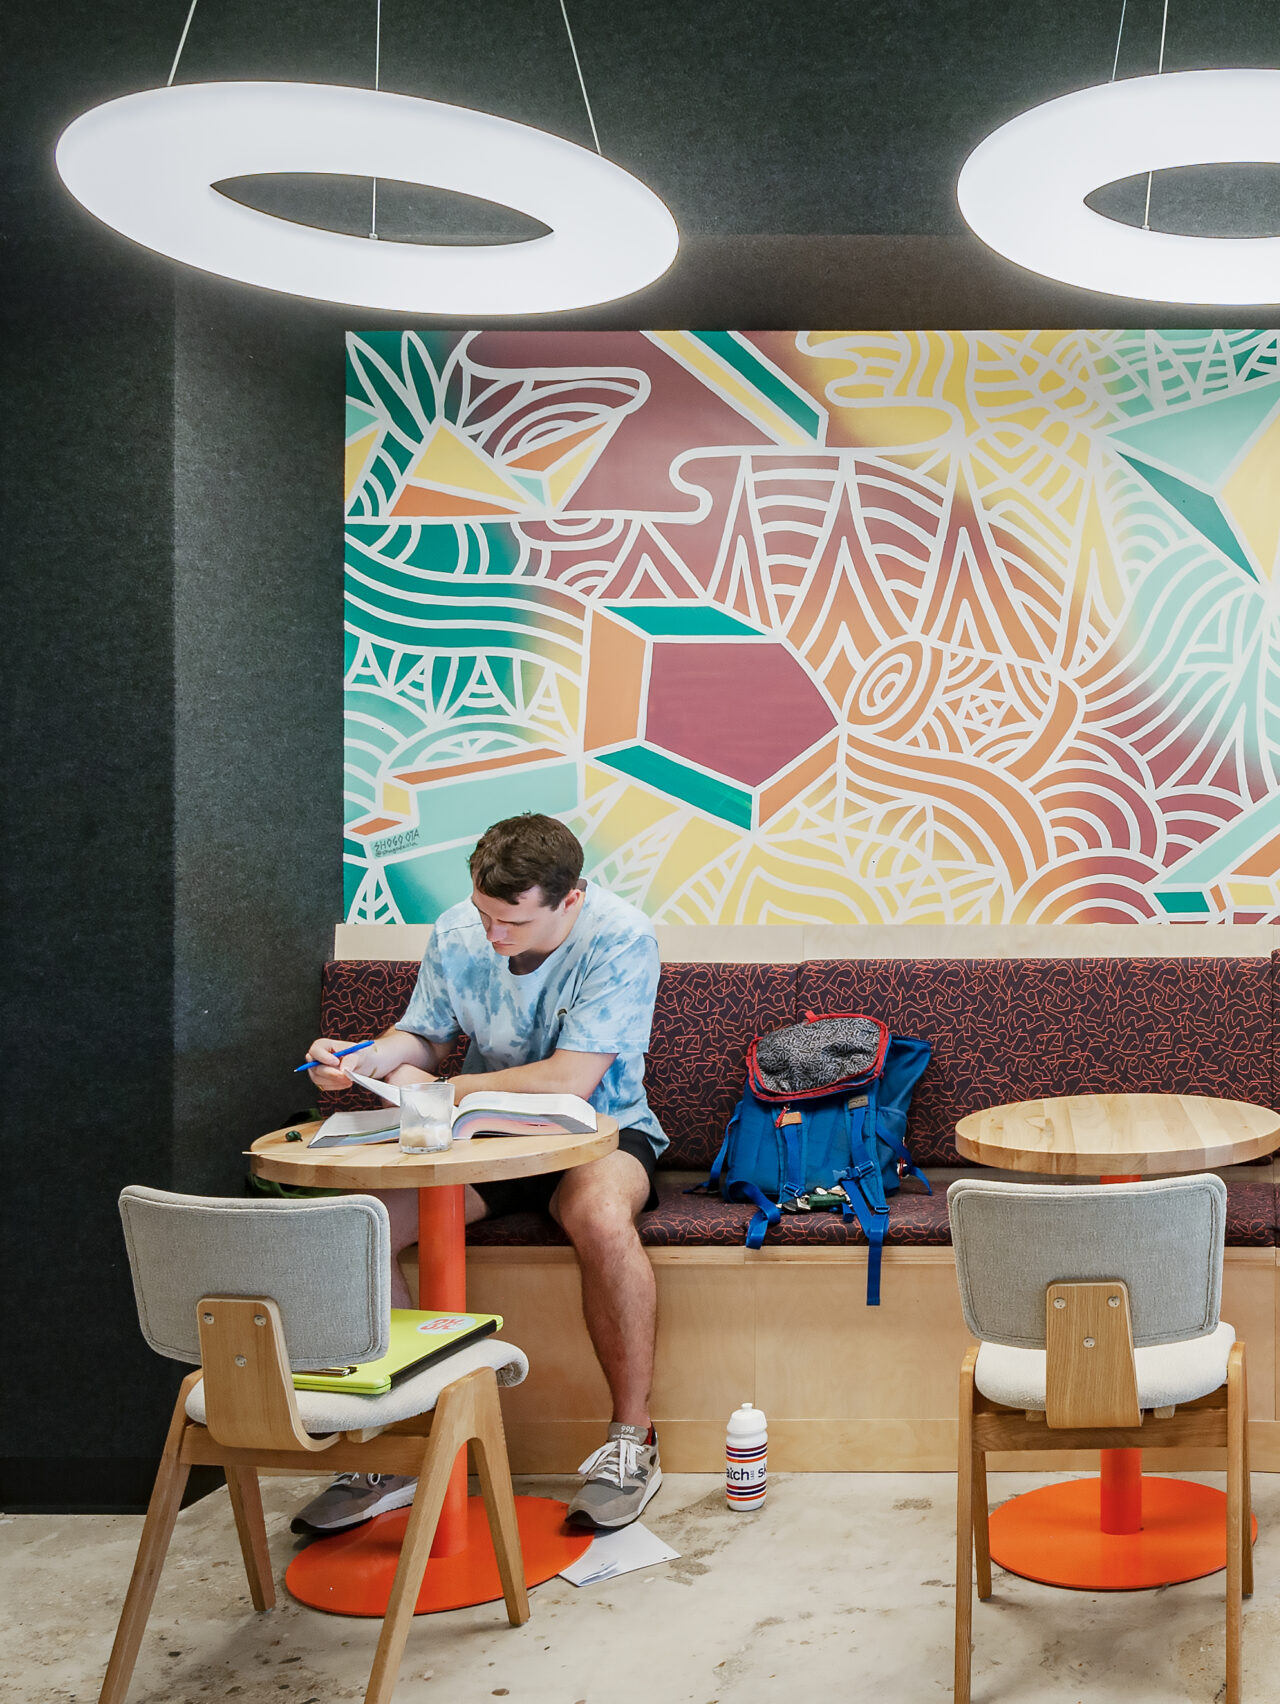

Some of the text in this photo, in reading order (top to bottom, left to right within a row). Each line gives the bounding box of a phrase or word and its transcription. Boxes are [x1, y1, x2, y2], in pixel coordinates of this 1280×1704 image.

[374, 828, 420, 852] SHOGO OTA
[620, 1425, 635, 1434] 998
